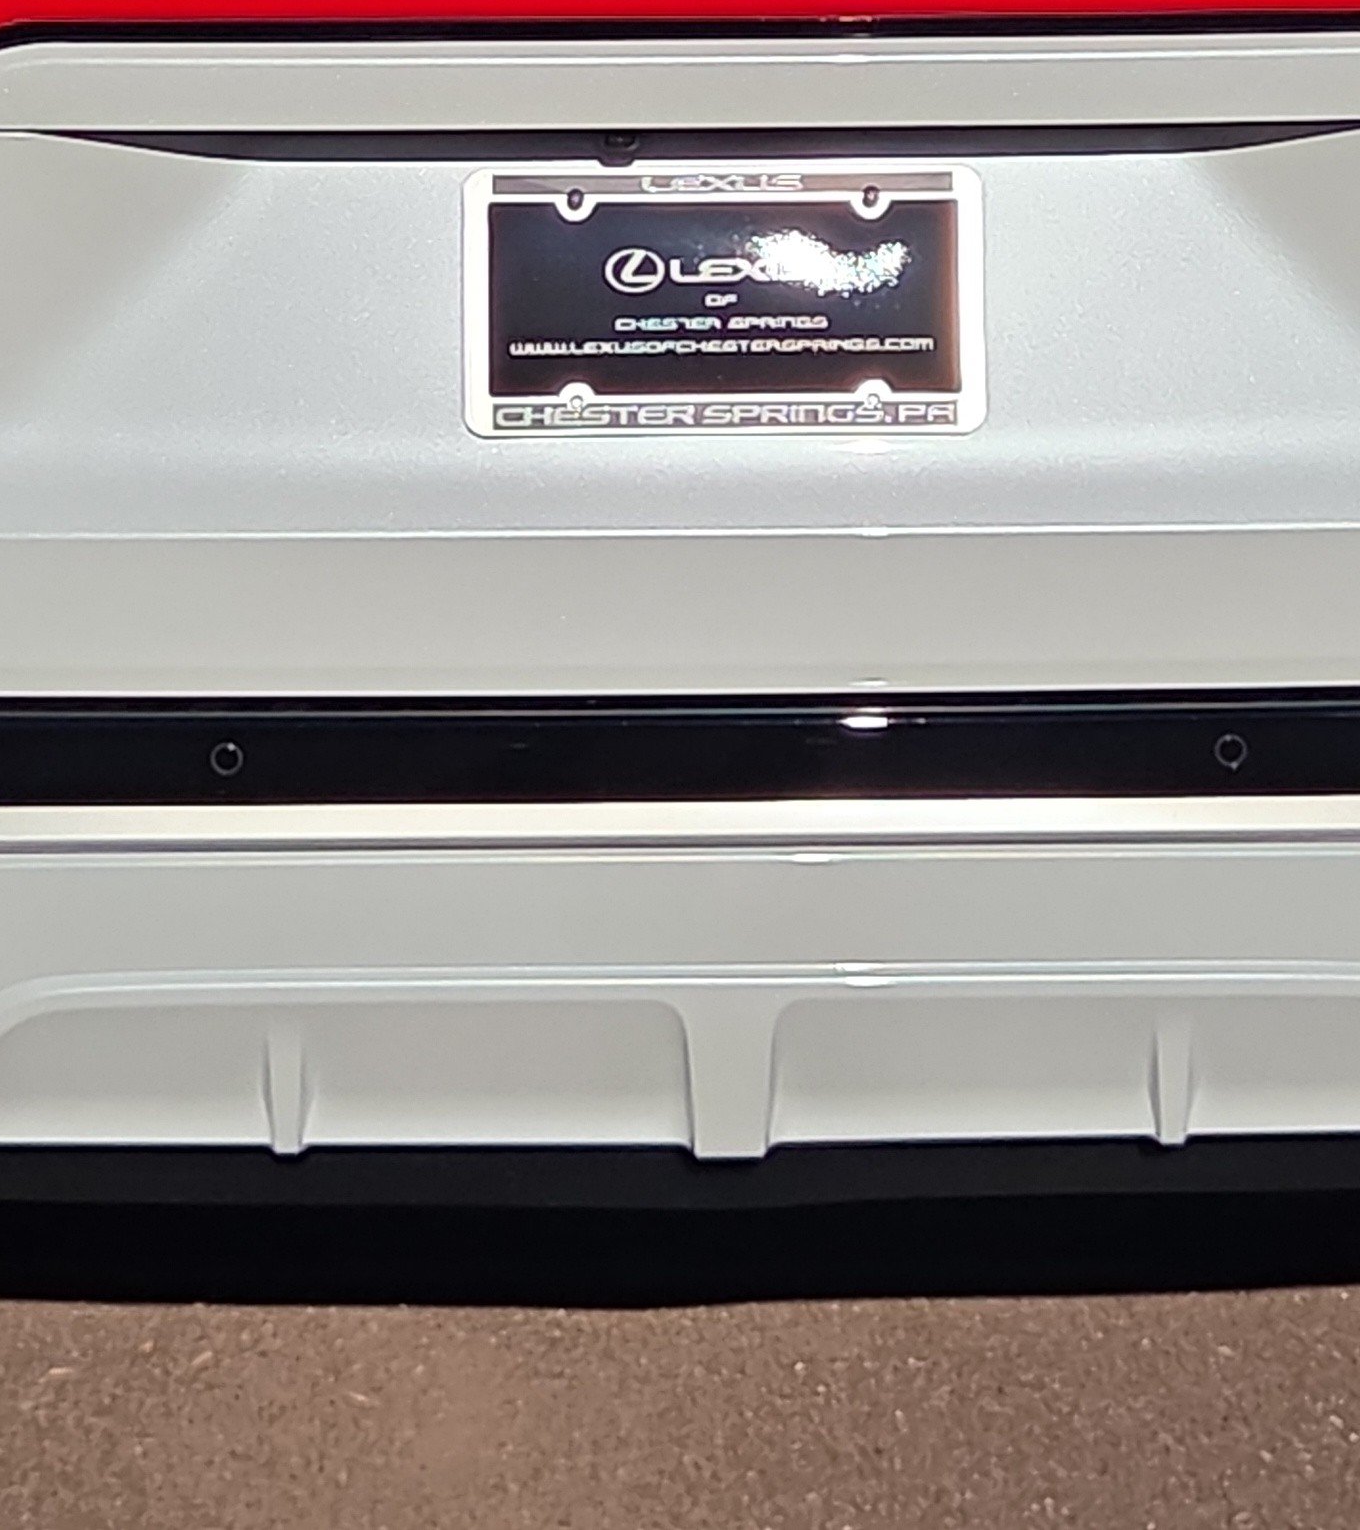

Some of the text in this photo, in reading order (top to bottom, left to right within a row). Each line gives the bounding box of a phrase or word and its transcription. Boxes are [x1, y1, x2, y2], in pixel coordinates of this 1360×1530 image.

[641, 174, 804, 192] LEXUS
[670, 256, 837, 283] LEX
[704, 293, 738, 307] OF
[615, 316, 828, 330] CHESTER SPRINGS
[495, 405, 695, 427] CHESTER
[899, 403, 956, 422] PA
